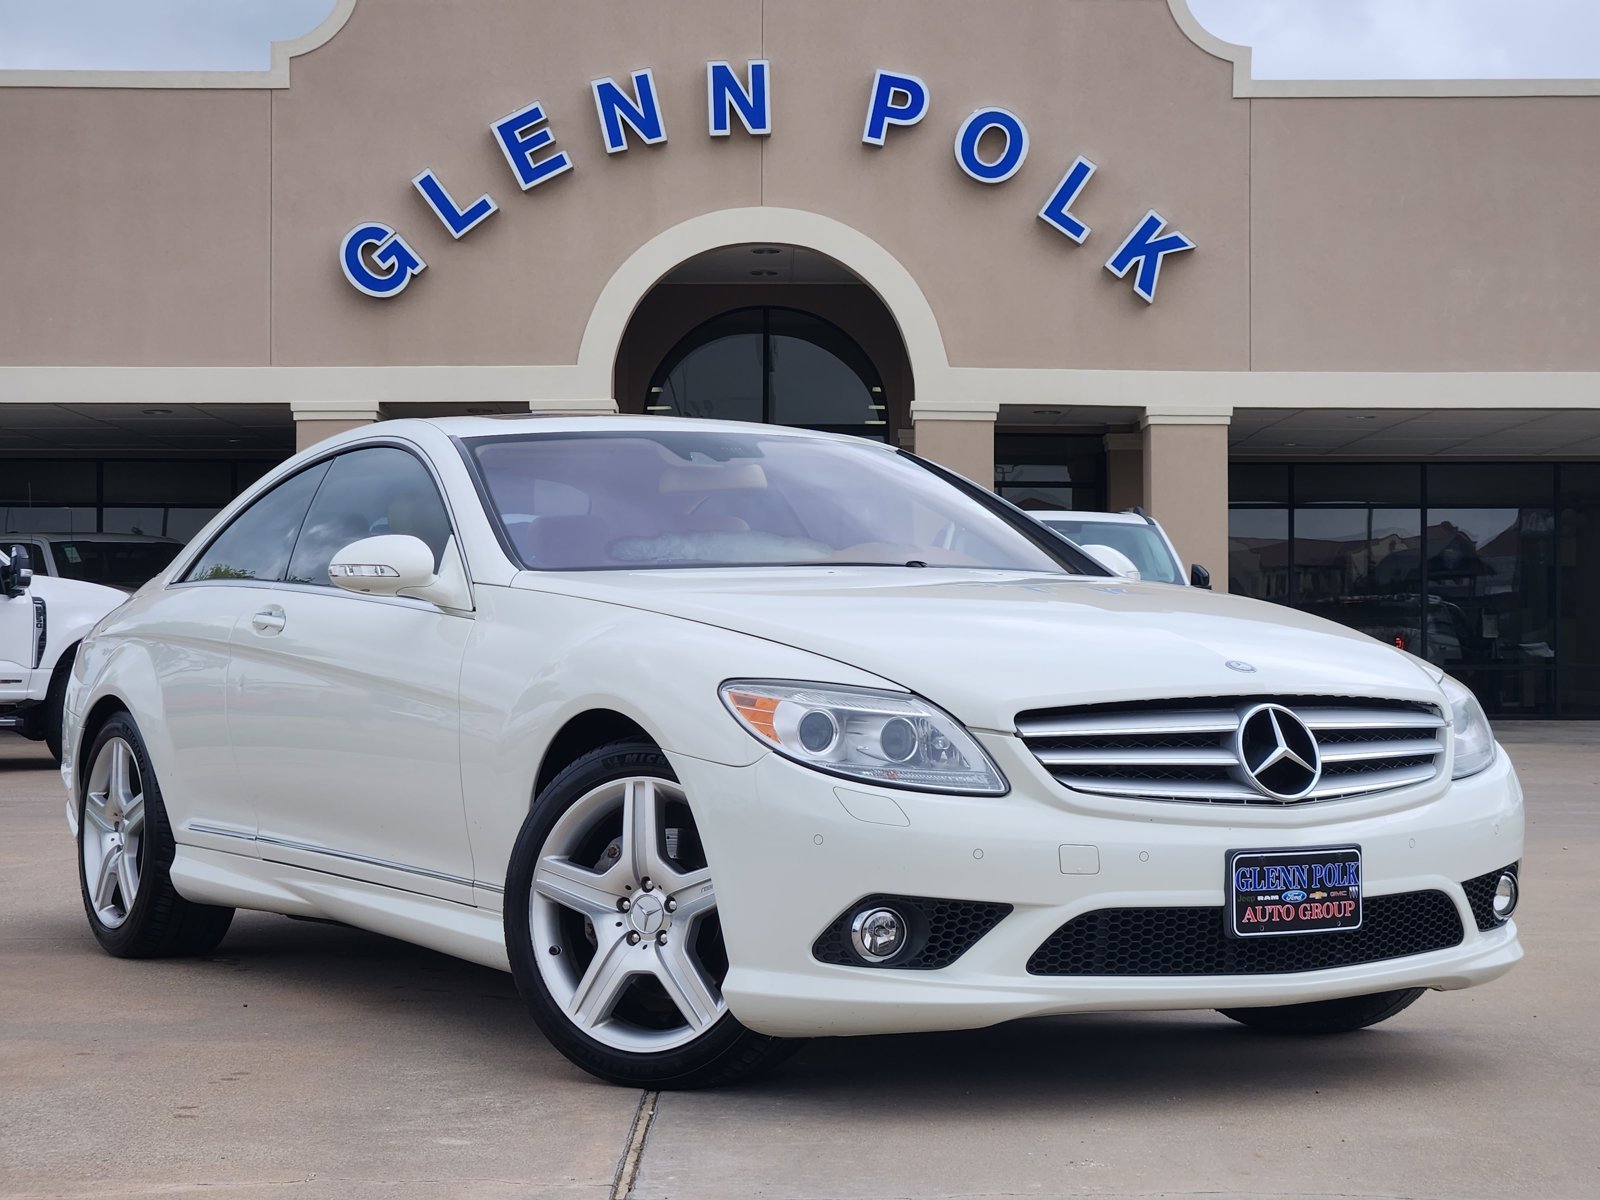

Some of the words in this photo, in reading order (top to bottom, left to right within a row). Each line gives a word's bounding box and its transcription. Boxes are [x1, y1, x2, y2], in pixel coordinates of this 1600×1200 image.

[339, 59, 771, 298] GLENN
[862, 69, 1197, 304] POLK
[1235, 865, 1308, 892] GLENN
[1312, 861, 1360, 888] POLK
[1284, 891, 1305, 901] Ford
[1242, 904, 1295, 923] AUTO
[1299, 901, 1355, 920] GROUP
